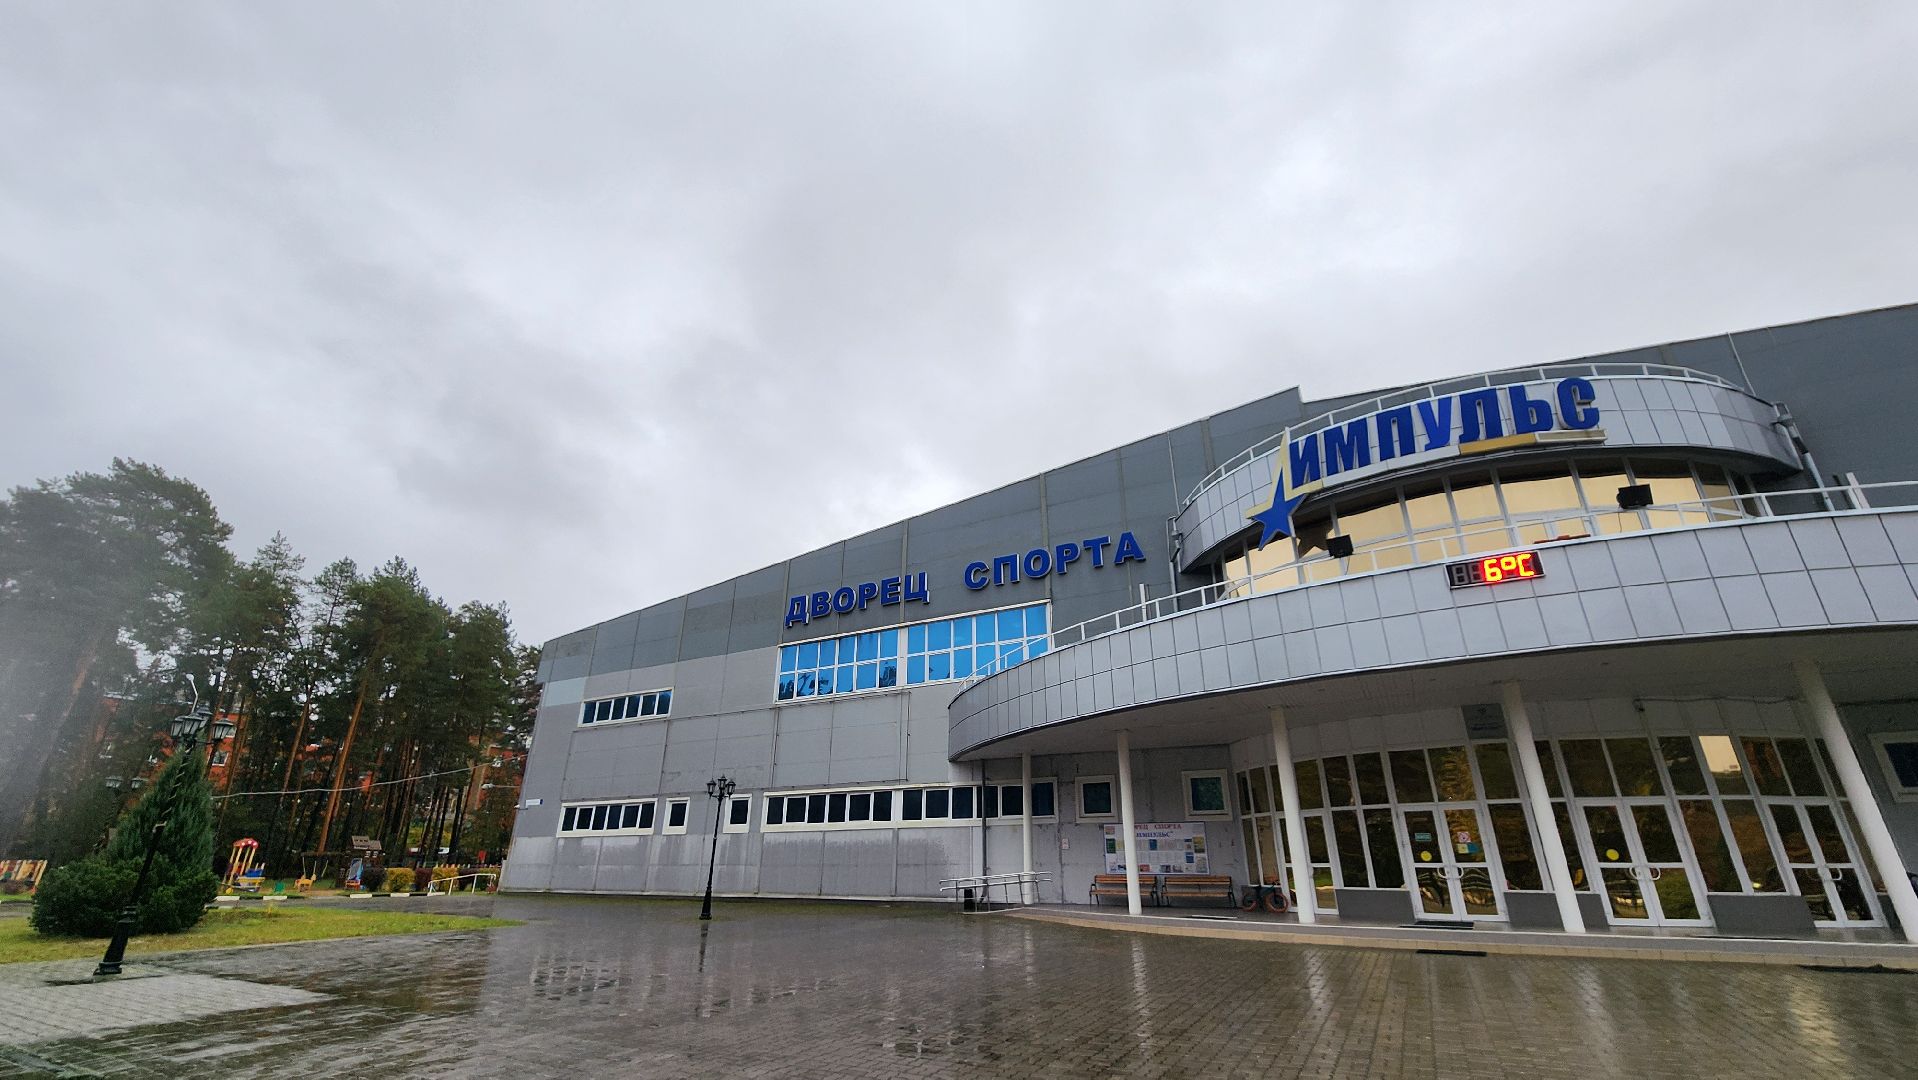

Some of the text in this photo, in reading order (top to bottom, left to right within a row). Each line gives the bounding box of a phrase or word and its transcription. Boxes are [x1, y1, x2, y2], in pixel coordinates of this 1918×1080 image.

[1289, 377, 1600, 489] ИМПУЛЬС
[785, 531, 1146, 627] ДВОРЕЦ СПОРТА
